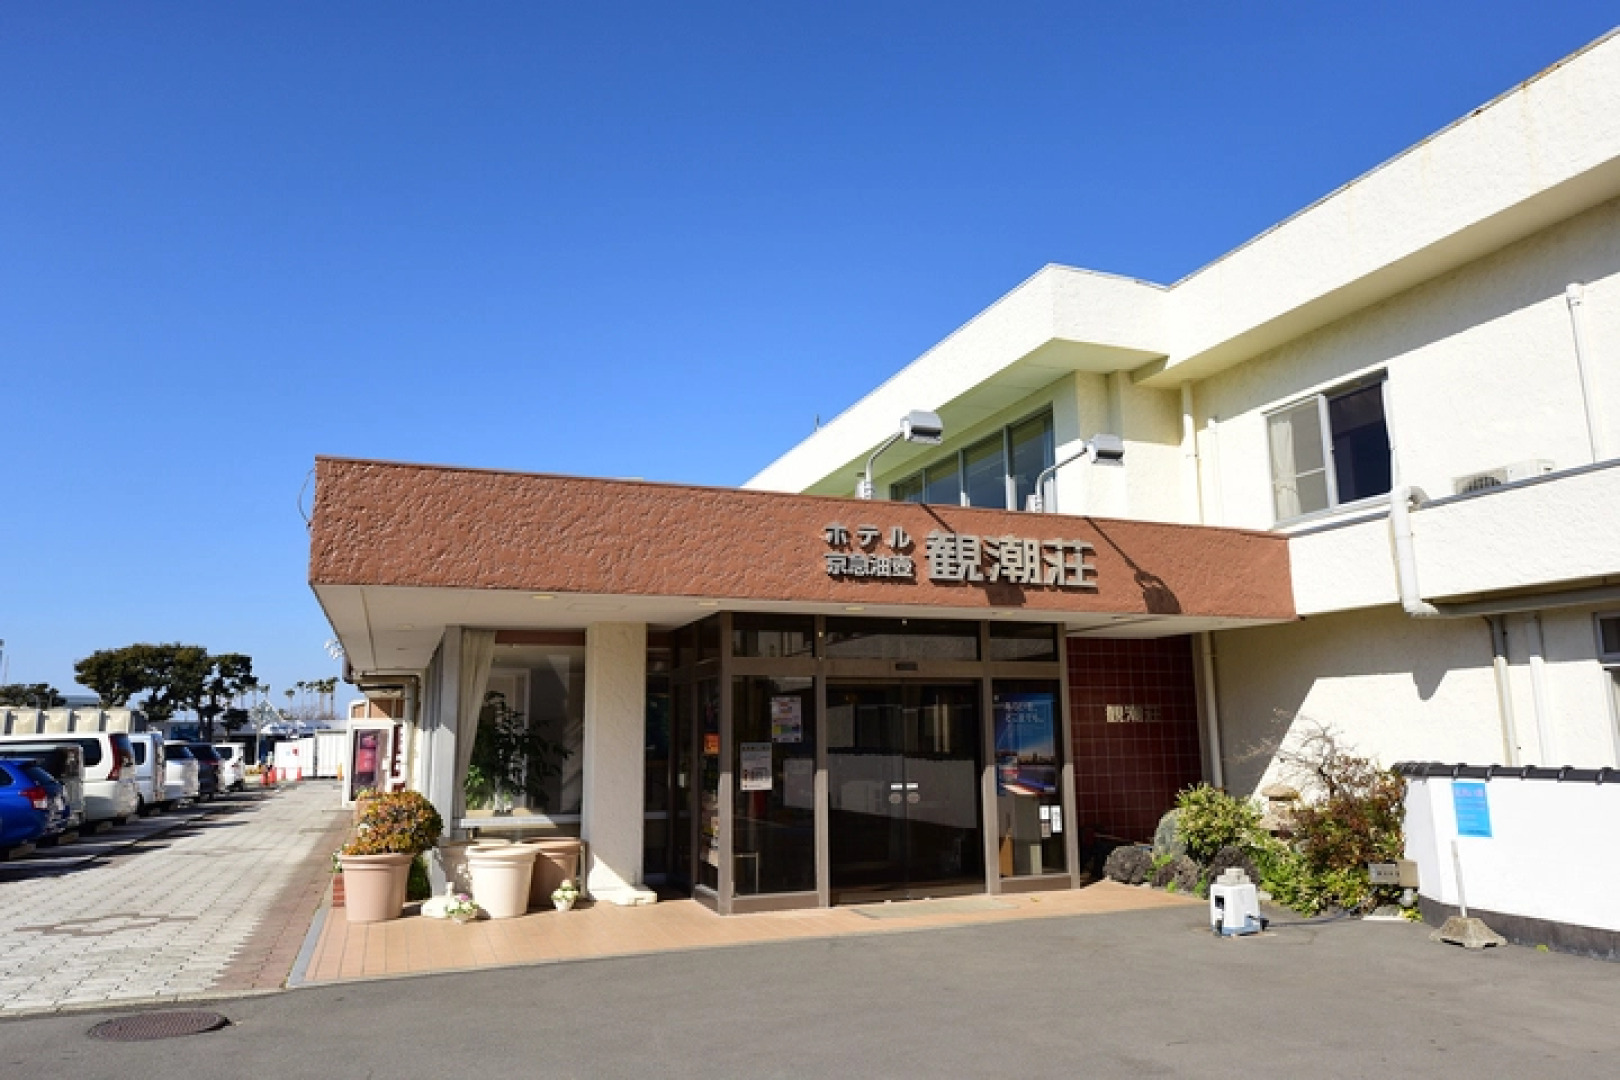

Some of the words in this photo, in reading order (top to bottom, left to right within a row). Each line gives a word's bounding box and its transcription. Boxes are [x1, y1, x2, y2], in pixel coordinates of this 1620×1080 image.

[825, 521, 911, 548] ホテル
[925, 529, 1097, 587] 観潮荘
